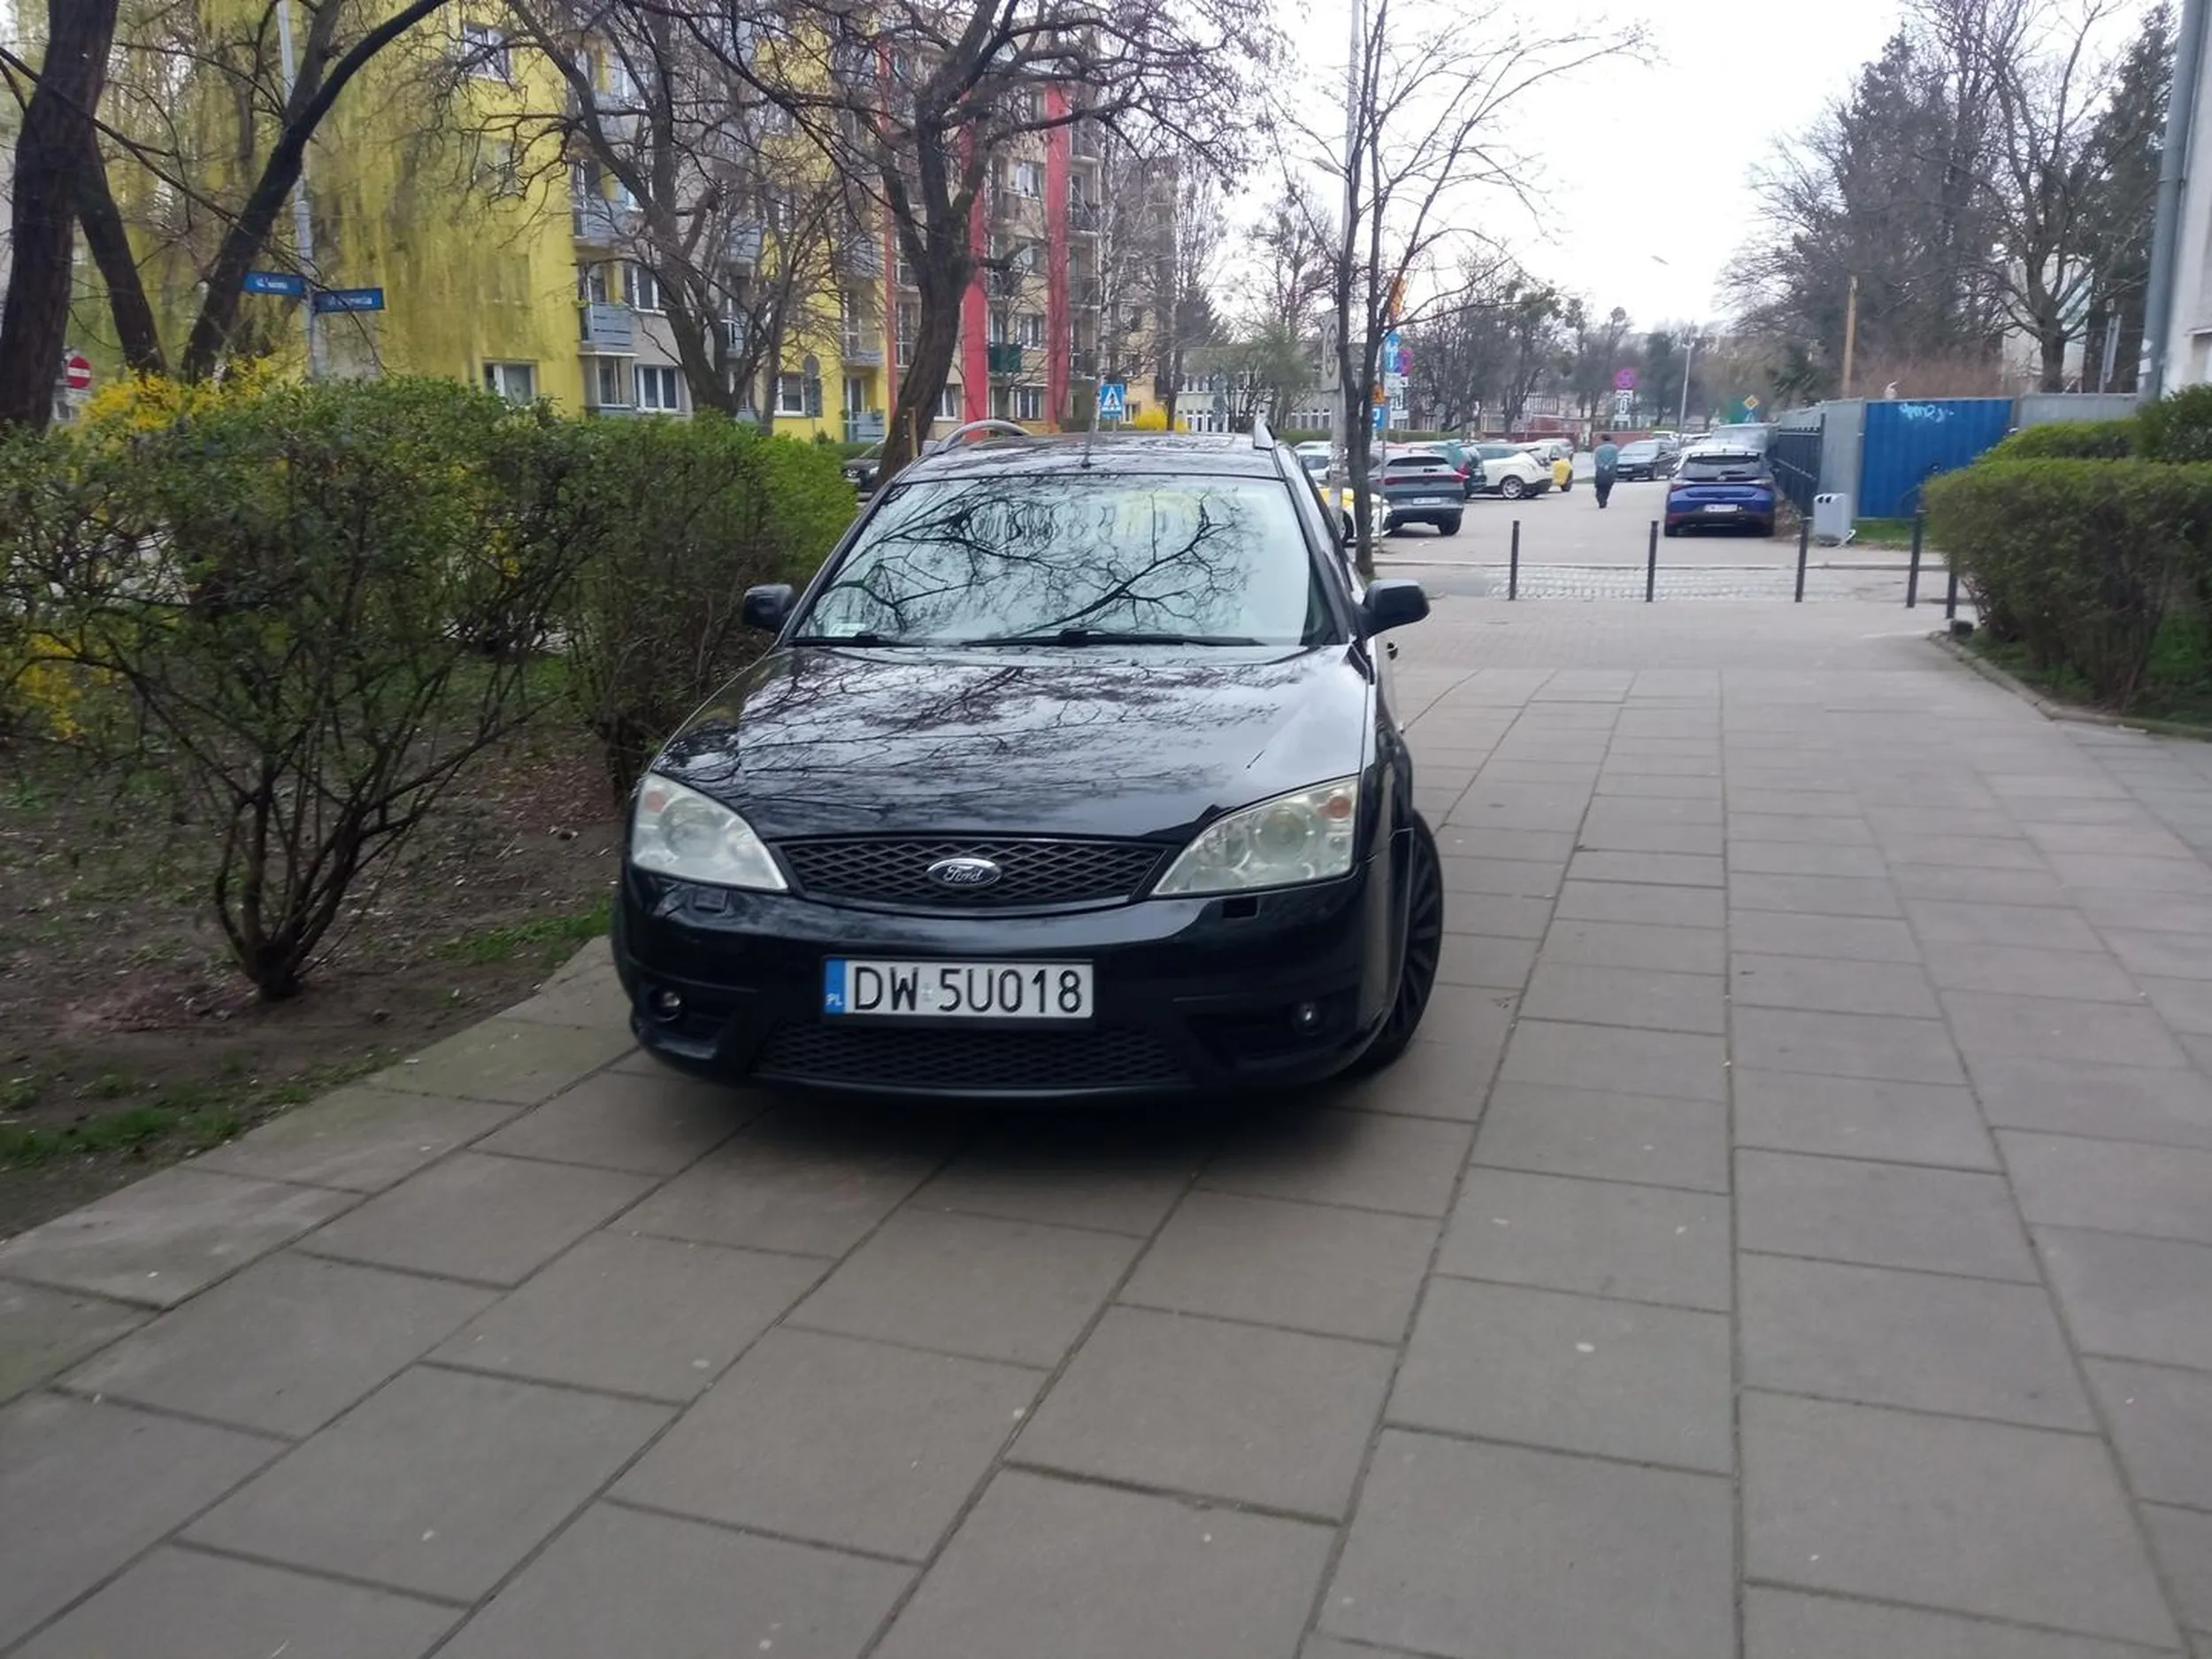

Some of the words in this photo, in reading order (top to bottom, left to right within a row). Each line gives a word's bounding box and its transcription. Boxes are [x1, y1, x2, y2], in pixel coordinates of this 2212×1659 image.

[943, 864, 984, 882] Ford
[854, 966, 918, 1011] DW
[938, 967, 1081, 1014] 5U018
[826, 993, 843, 1006] PL
